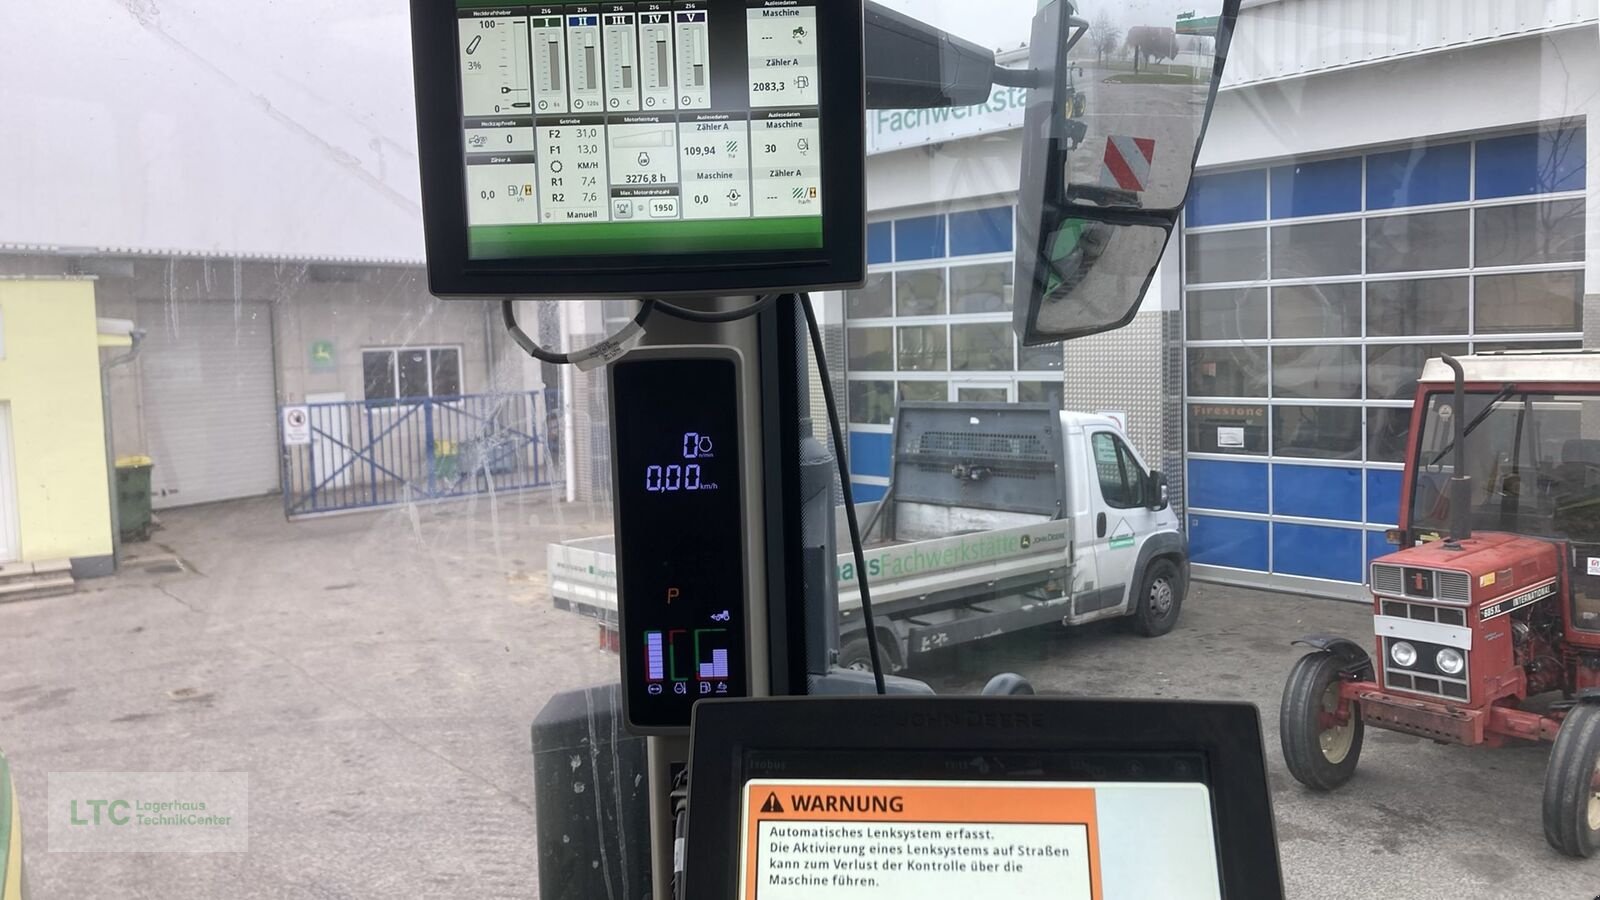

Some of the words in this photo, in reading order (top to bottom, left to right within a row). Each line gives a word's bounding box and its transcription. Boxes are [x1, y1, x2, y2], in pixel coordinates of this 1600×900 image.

[686, 13, 695, 22] V
[762, 9, 799, 17] Maschine
[479, 20, 495, 28] 100
[578, 17, 587, 26] II
[612, 16, 626, 25] III
[649, 15, 662, 23] IV
[467, 61, 482, 70] 3%
[766, 58, 791, 66] Zähler
[792, 58, 799, 66] A
[753, 82, 785, 92] 2083,3
[494, 104, 500, 113] 0
[696, 123, 720, 131] Zähler
[722, 123, 729, 131] A
[766, 120, 803, 128] Maschine
[549, 129, 561, 139] F2
[576, 128, 597, 138] 31,0
[506, 134, 512, 144] 0
[550, 145, 561, 155] F1
[577, 144, 598, 155] 13,0
[684, 146, 716, 156] 109,94
[765, 143, 777, 153] 30
[577, 161, 599, 169] KM/H
[626, 173, 657, 184] 3276,8
[659, 173, 666, 182] h
[696, 171, 733, 180] Maschine
[769, 170, 794, 178] Zähler
[795, 169, 802, 177] A
[551, 177, 563, 186] R1
[581, 176, 596, 187] 7,4
[480, 190, 495, 200] 0,0
[552, 193, 565, 202] R2
[582, 192, 597, 203] 7,6
[694, 195, 708, 205] 0,0
[654, 204, 673, 212] 1950
[566, 211, 598, 219] Manuell
[1193, 405, 1264, 416] Firestone
[683, 432, 699, 459] 0
[646, 463, 701, 493] 0,00
[700, 482, 718, 490] km/h
[666, 587, 680, 604] P
[791, 794, 904, 813] WARNUNG
[769, 826, 863, 838] Automatisches
[867, 828, 942, 842] Lenksystem
[945, 828, 995, 840] erfasst.
[770, 842, 790, 853] Die
[793, 843, 865, 856] Aktivierung
[869, 844, 903, 855] eines
[907, 845, 989, 859] Lenksystems
[992, 844, 1014, 856] auf
[1017, 845, 1070, 857] Straßen
[769, 858, 800, 869] kann
[803, 860, 830, 869] zum
[833, 859, 878, 871] Verlust
[882, 859, 902, 871] der
[906, 860, 967, 873] Kontrolle
[970, 861, 1000, 872] über
[1003, 861, 1024, 873] die
[769, 875, 829, 886] Maschine
[832, 875, 879, 887] führen.
